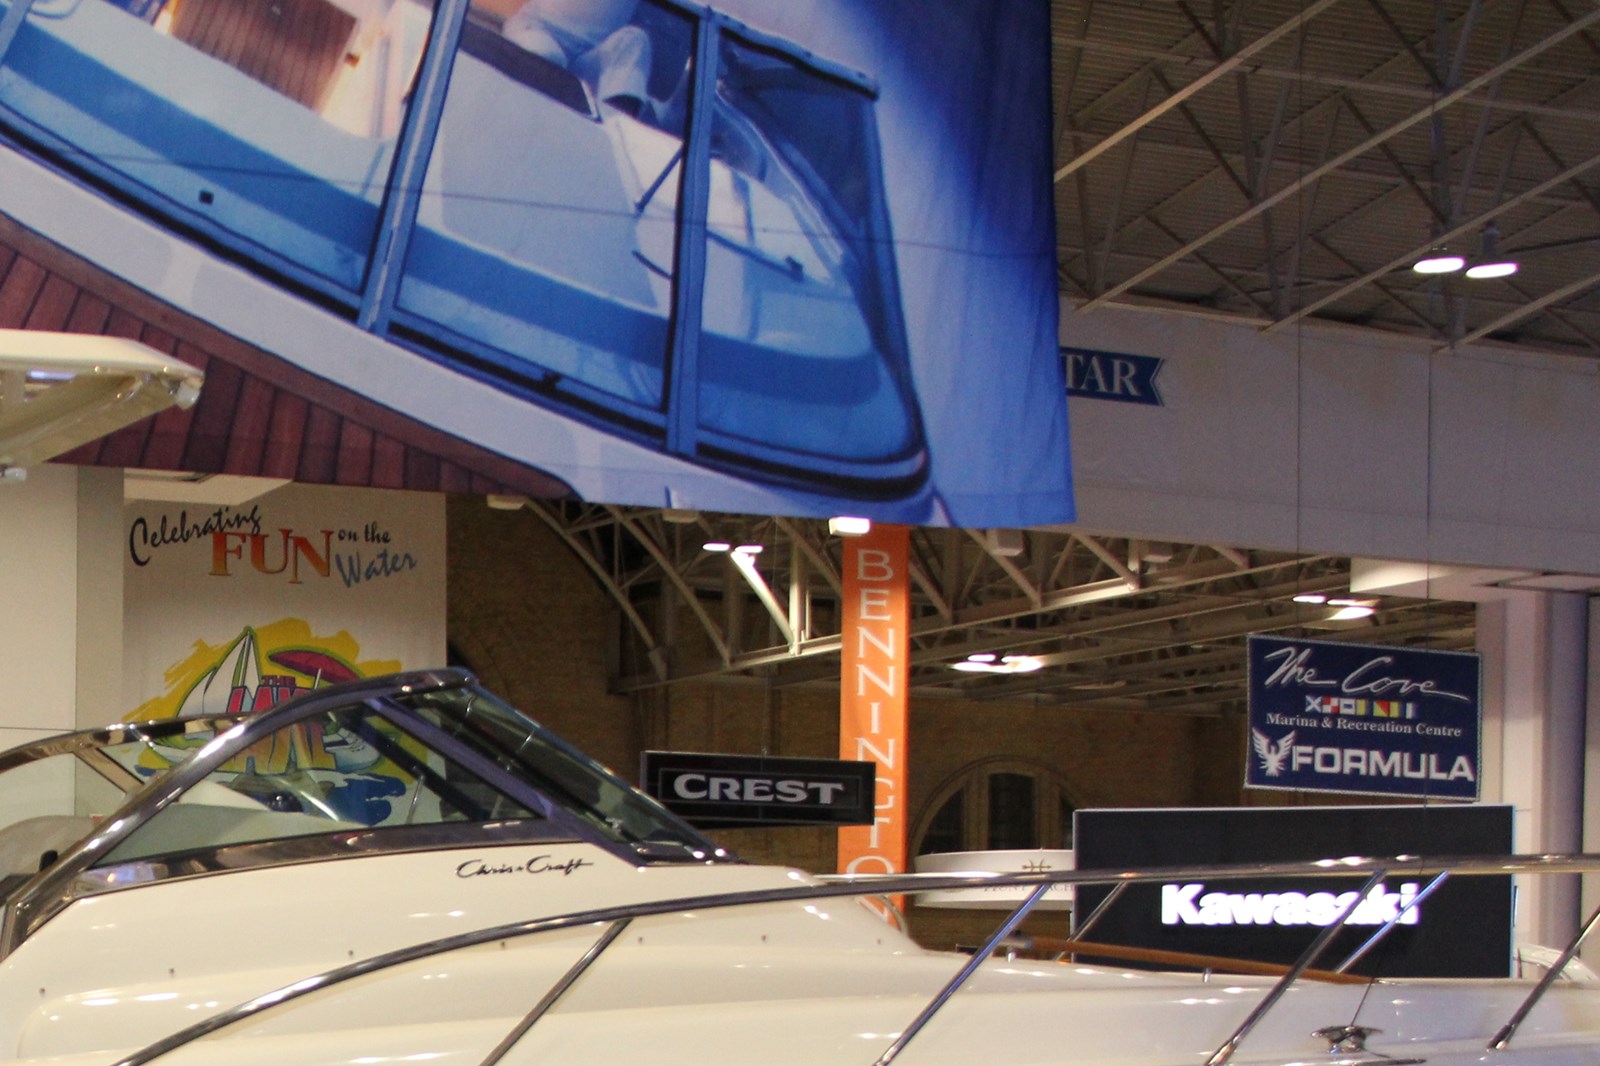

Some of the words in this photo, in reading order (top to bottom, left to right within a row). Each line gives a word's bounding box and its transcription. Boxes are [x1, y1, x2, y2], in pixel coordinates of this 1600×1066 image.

[129, 505, 261, 566] Celebrating
[209, 529, 334, 584] FUN
[338, 529, 358, 542] on
[364, 521, 392, 544] the
[335, 548, 418, 588] Water
[1264, 646, 1338, 688] The
[1341, 656, 1471, 703] Cove
[845, 549, 896, 923] BENNINGT
[1266, 712, 1318, 728] Marina
[1321, 717, 1333, 729] &
[1337, 717, 1413, 735] Recreation
[1416, 723, 1462, 738] Centre
[1291, 745, 1476, 783] FORMULA
[673, 773, 844, 805] CREST
[1161, 882, 1420, 926] Kawasaki
